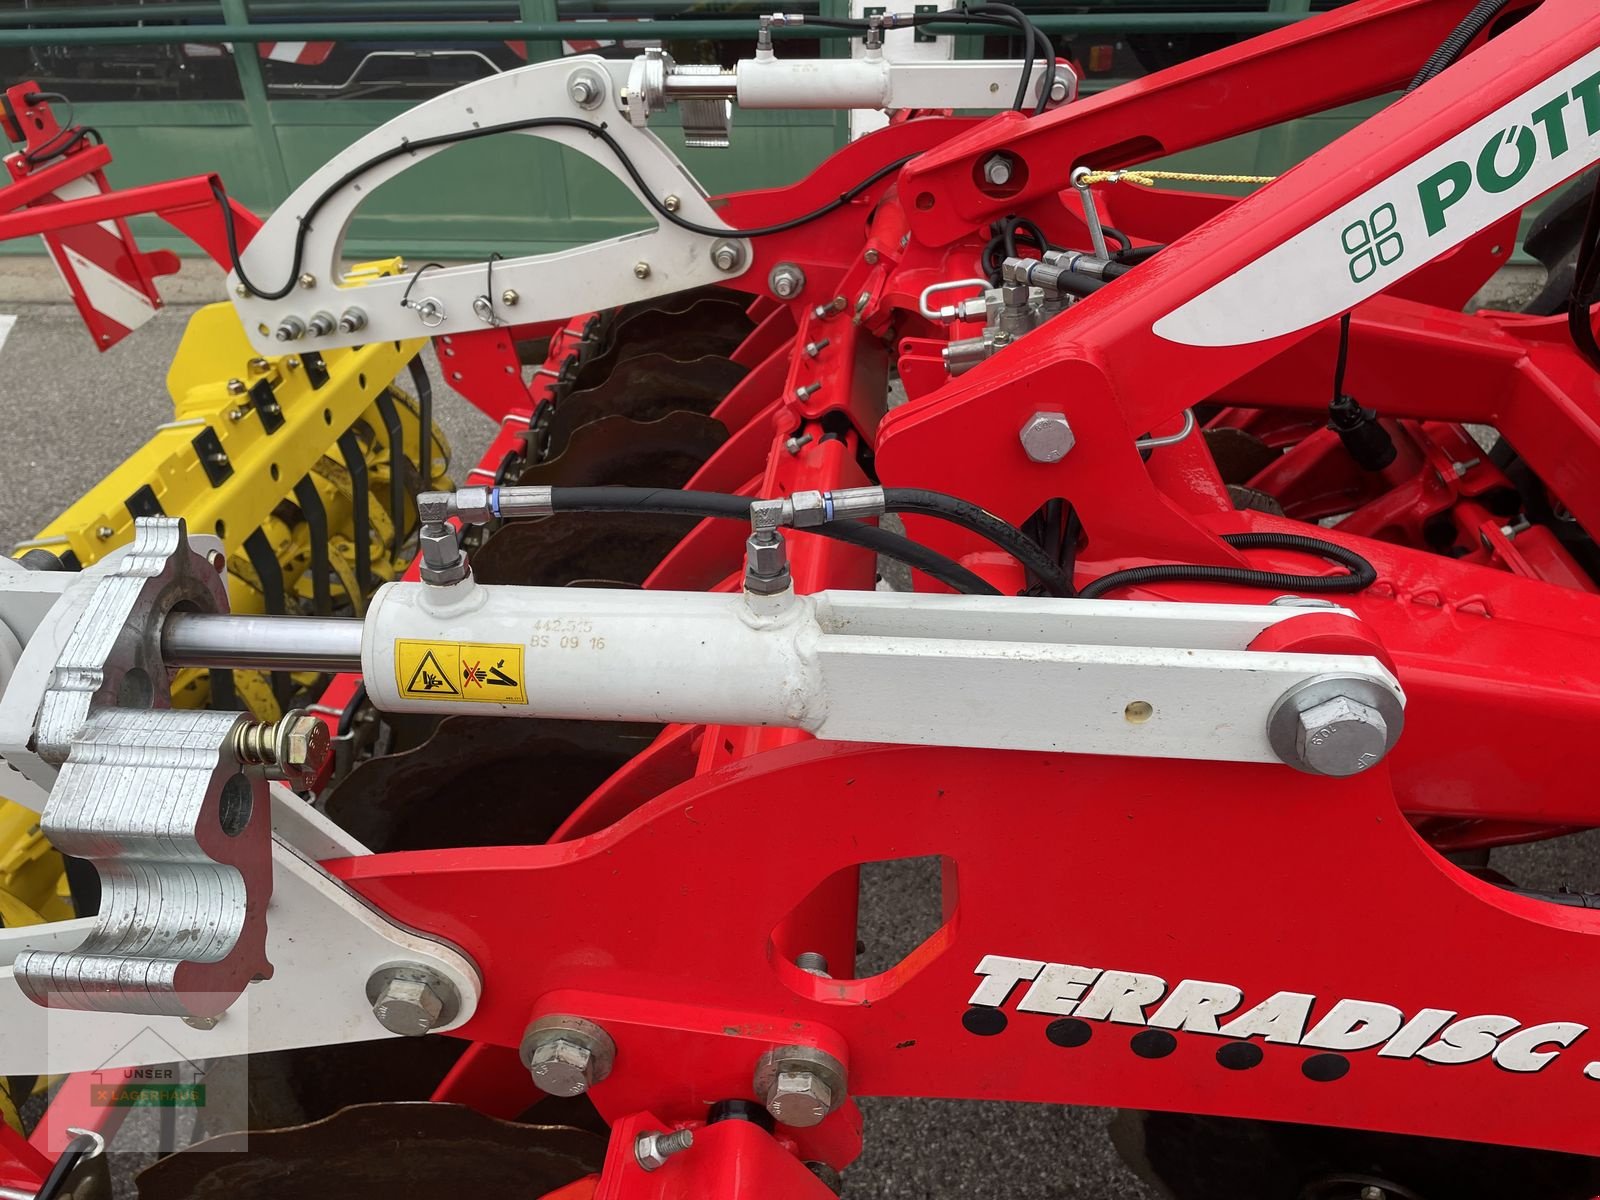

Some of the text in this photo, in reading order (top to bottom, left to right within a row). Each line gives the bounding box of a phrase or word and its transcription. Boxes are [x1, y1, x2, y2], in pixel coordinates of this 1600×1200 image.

[560, 635, 580, 649] 09
[589, 637, 606, 650] 16
[967, 953, 1590, 1074] TERRADISC
